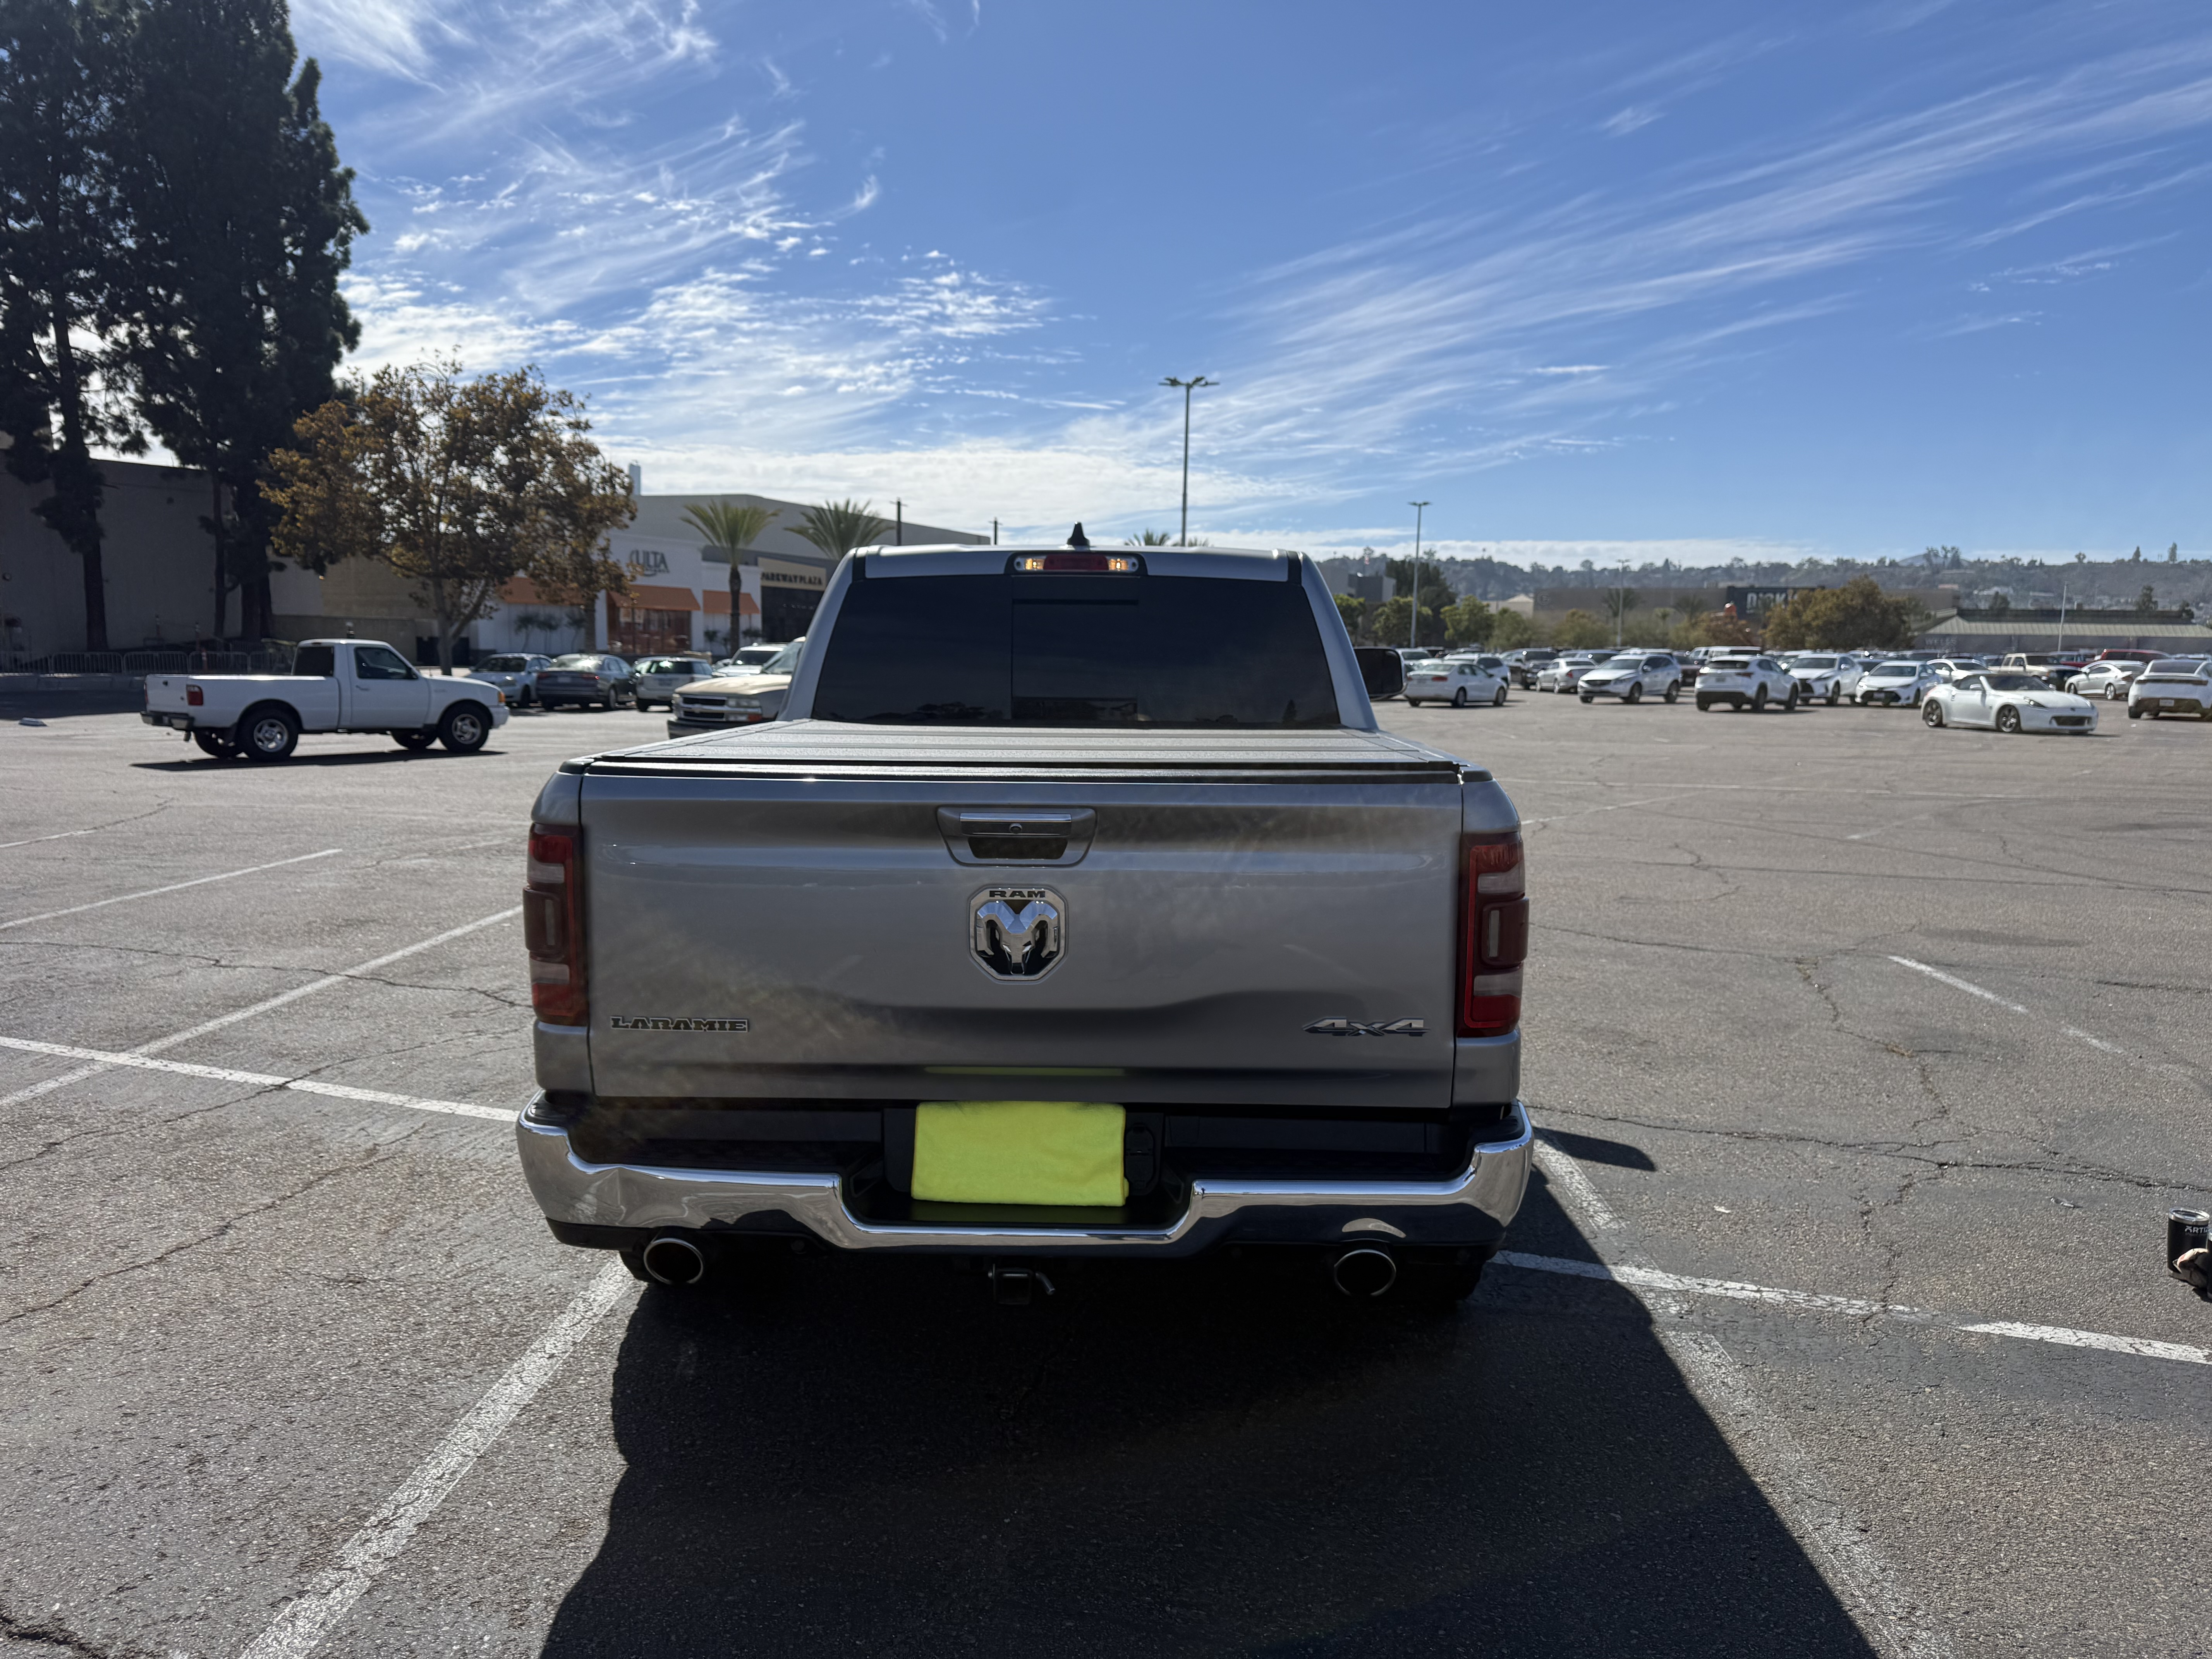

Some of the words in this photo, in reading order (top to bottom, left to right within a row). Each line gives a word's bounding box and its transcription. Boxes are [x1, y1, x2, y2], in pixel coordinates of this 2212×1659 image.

[634, 549, 669, 570] ULTA
[761, 572, 798, 583] PARKWAY
[799, 575, 823, 585] PLAZA
[610, 1016, 748, 1033] LARAMIE
